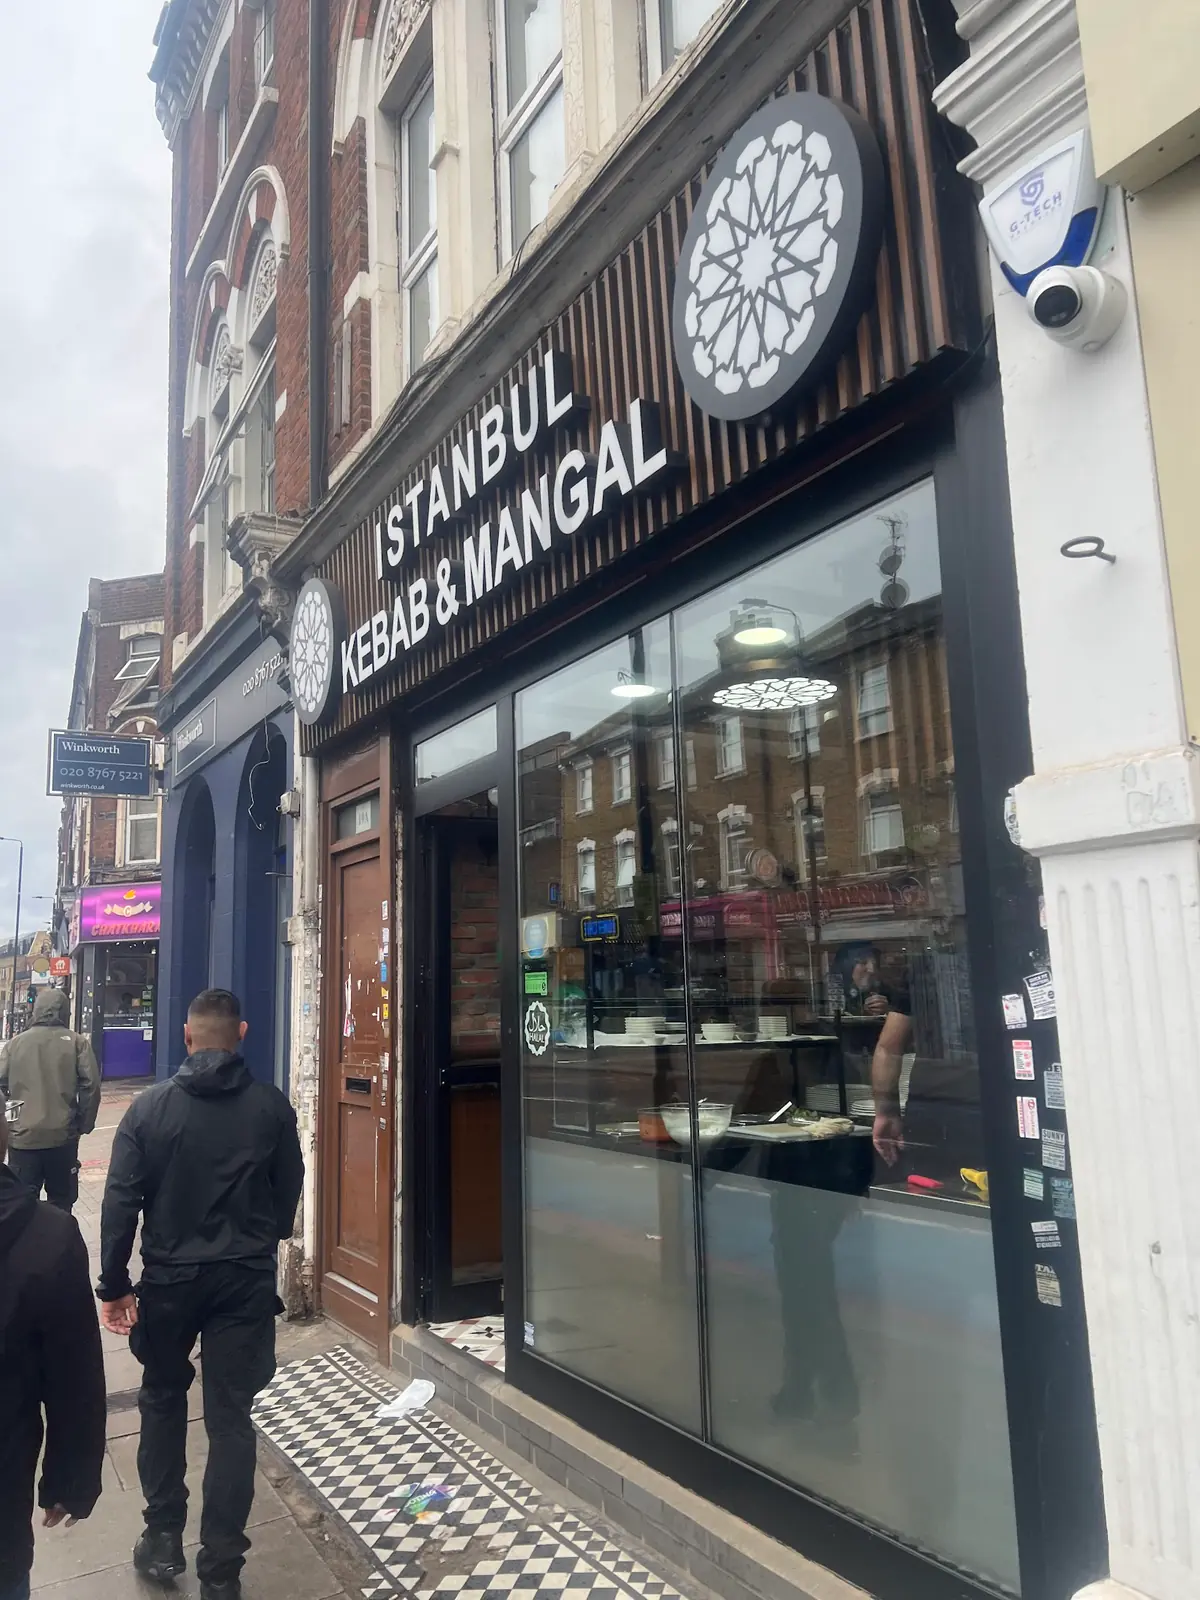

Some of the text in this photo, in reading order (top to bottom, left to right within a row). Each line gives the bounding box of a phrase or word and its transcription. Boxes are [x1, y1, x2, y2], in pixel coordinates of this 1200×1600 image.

[1010, 192, 1062, 232] G-TECH
[375, 349, 573, 580] ISTANBUL
[341, 398, 667, 694] KEBAB & MANGAL
[242, 677, 255, 696] 020
[255, 661, 270, 688] 8767
[61, 741, 120, 754] Winkworth
[60, 767, 143, 781] 020 8767 5221
[529, 1032, 545, 1043] HALAL
[1043, 1129, 1065, 1141] SUNNY
